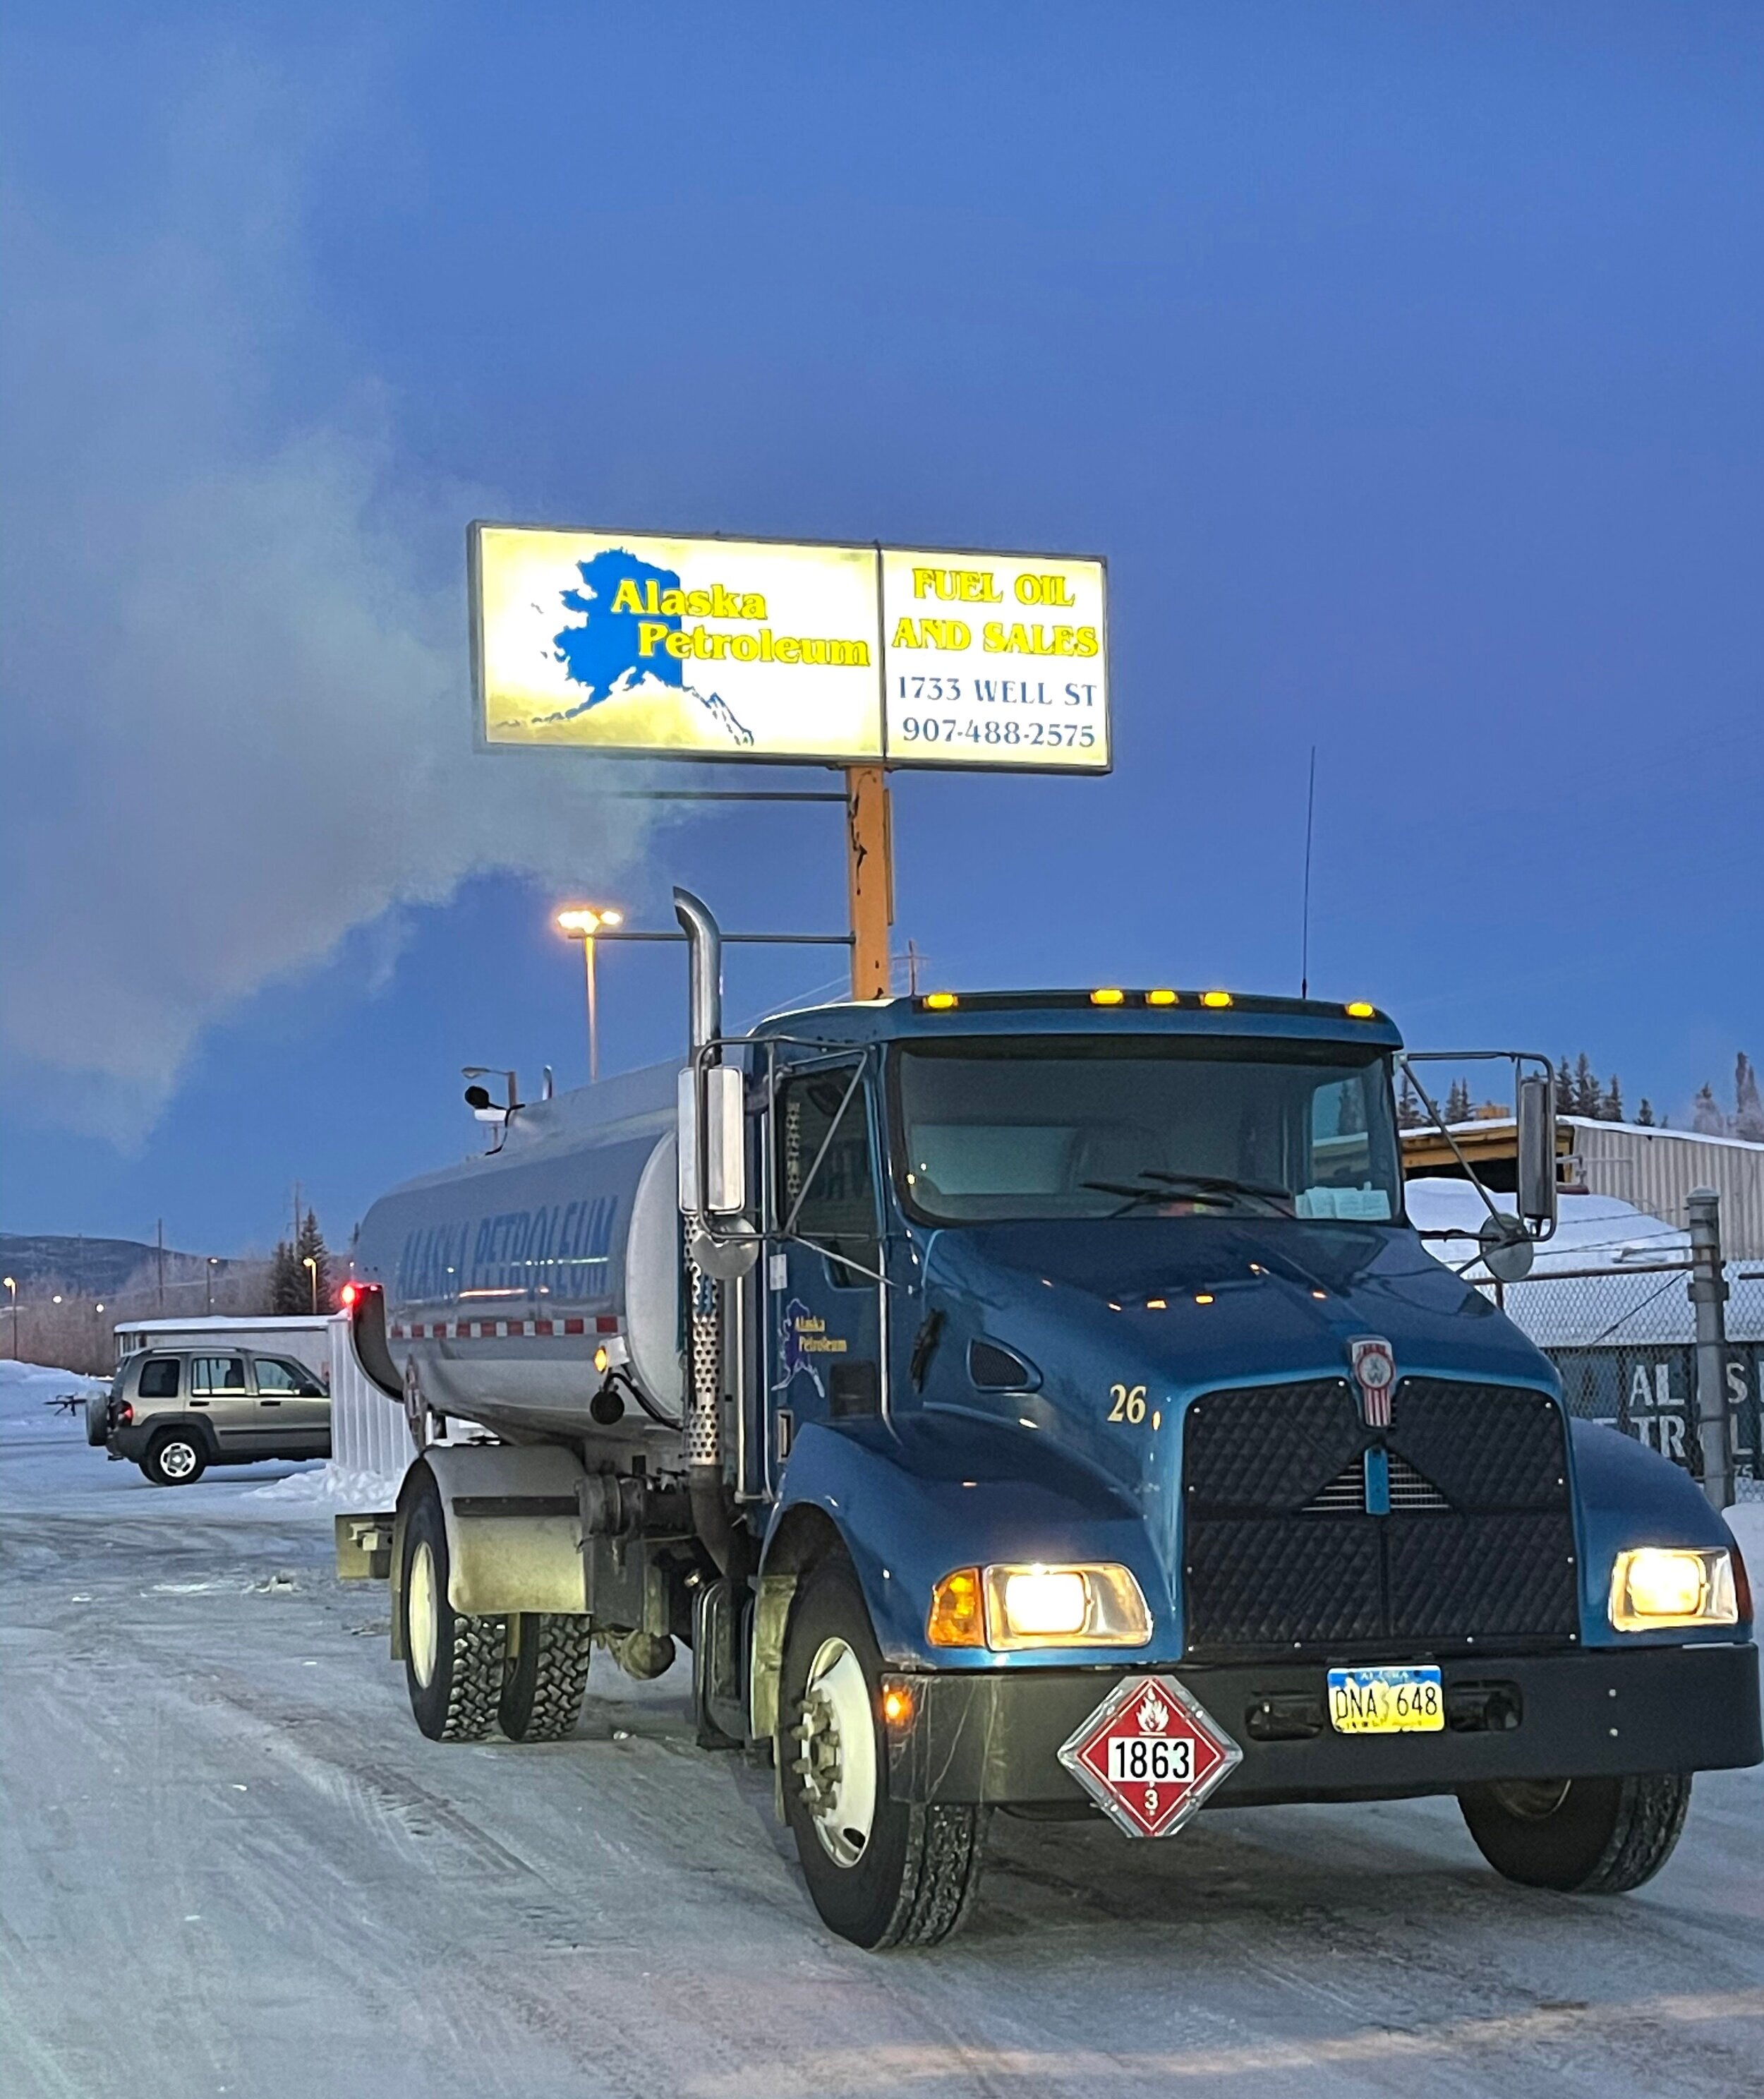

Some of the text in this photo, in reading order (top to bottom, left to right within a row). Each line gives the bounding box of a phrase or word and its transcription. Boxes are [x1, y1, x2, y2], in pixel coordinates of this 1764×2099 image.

[610, 579, 768, 620] Alaska
[912, 567, 1075, 606] FUEL OIL
[638, 621, 871, 667] Petroleum
[892, 618, 1099, 657] AND SALES
[899, 676, 1097, 706] 1733 WELL ST
[902, 717, 1095, 748] 907-488-2575
[1107, 1384, 1147, 1424] 26
[1336, 1686, 1437, 1719] DNA 648
[1116, 1740, 1189, 1779] 1863
[1144, 1789, 1159, 1810] 3
